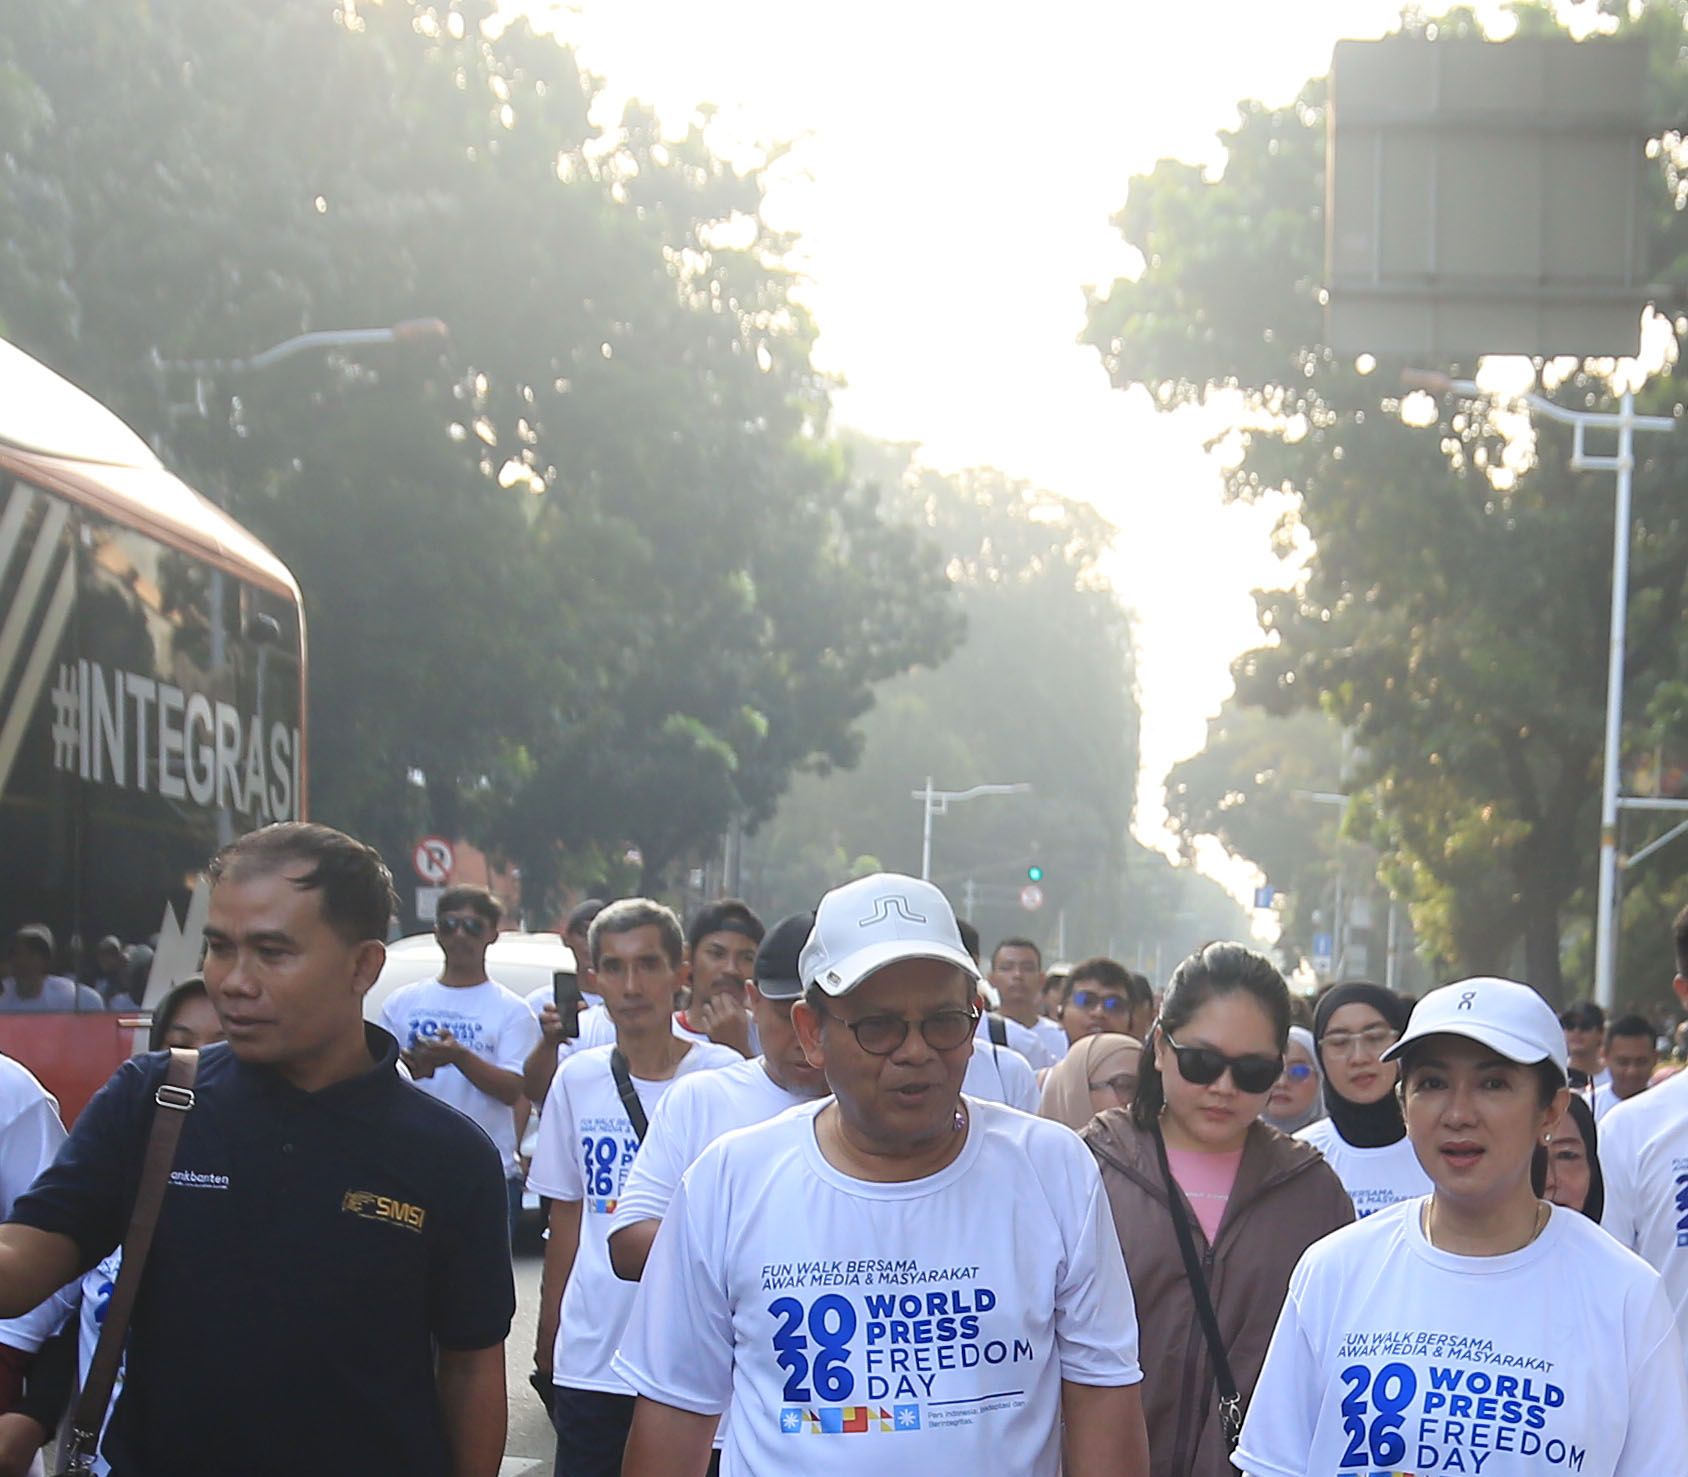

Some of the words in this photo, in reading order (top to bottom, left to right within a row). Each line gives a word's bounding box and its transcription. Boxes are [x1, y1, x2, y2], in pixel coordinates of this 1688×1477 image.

[582, 1137, 617, 1166] 20
[585, 1165, 614, 1196] 26
[376, 1197, 425, 1228] SMSI
[761, 1263, 792, 1279] FUN
[797, 1261, 842, 1275] WALK
[846, 1259, 918, 1274] BERSAMA
[762, 1274, 807, 1291] AWAK
[811, 1273, 860, 1287] MEDIA
[865, 1274, 874, 1286] &
[878, 1266, 980, 1285] MASYARAKAT
[864, 1288, 997, 1320] WORLD
[767, 1294, 857, 1351] 20
[865, 1315, 980, 1346] PRESS
[866, 1338, 1033, 1374] FREEDOM
[1371, 1331, 1415, 1345] WALK
[1416, 1332, 1493, 1352] BERSAMA
[1337, 1345, 1378, 1358] AWAK
[1381, 1343, 1427, 1357] MEDIA
[1432, 1346, 1443, 1358] &
[1446, 1347, 1555, 1374] MASYARAKAT
[777, 1347, 855, 1402] 26
[867, 1373, 937, 1400] DAY
[1340, 1362, 1417, 1417] 20
[1428, 1366, 1566, 1408] WORLD
[1423, 1391, 1546, 1429] PRESS
[1338, 1410, 1406, 1468] 26
[1418, 1418, 1586, 1473] FREEDOM
[1416, 1444, 1491, 1474] DAY
